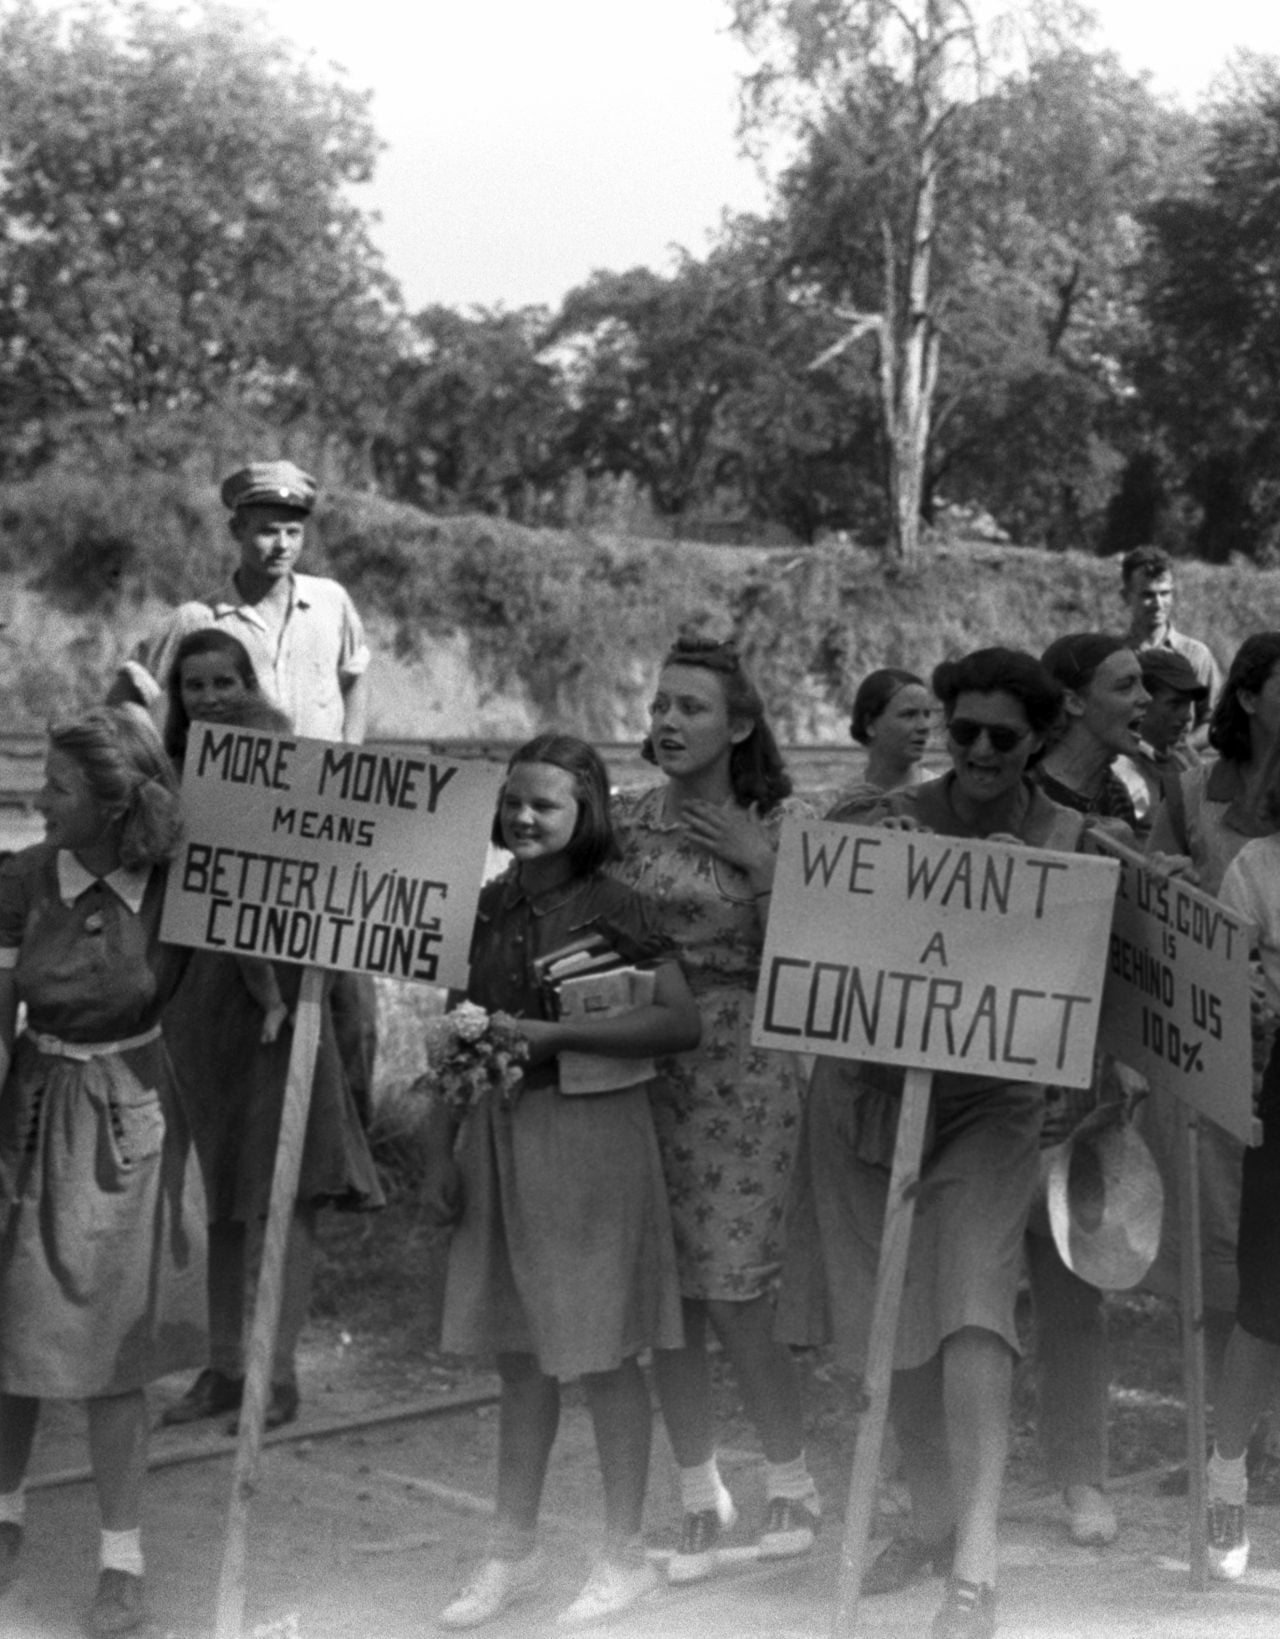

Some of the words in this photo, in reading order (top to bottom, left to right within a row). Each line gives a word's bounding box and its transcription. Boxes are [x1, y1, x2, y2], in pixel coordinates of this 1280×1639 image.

[197, 729, 297, 791] MORE
[318, 748, 459, 813] MONEY
[272, 806, 376, 847] MEANS
[182, 842, 320, 911] BETTER
[324, 861, 449, 932] LIVING
[802, 831, 881, 894] WE
[907, 843, 1069, 919] WANT
[205, 899, 443, 981] CONDITIONS
[919, 931, 948, 967] A
[1162, 926, 1177, 960] IS
[763, 956, 1092, 1070] CONTRACT
[1110, 932, 1175, 1009] BEHIND
[1190, 983, 1222, 1041] US
[1142, 1005, 1205, 1074] 100%
